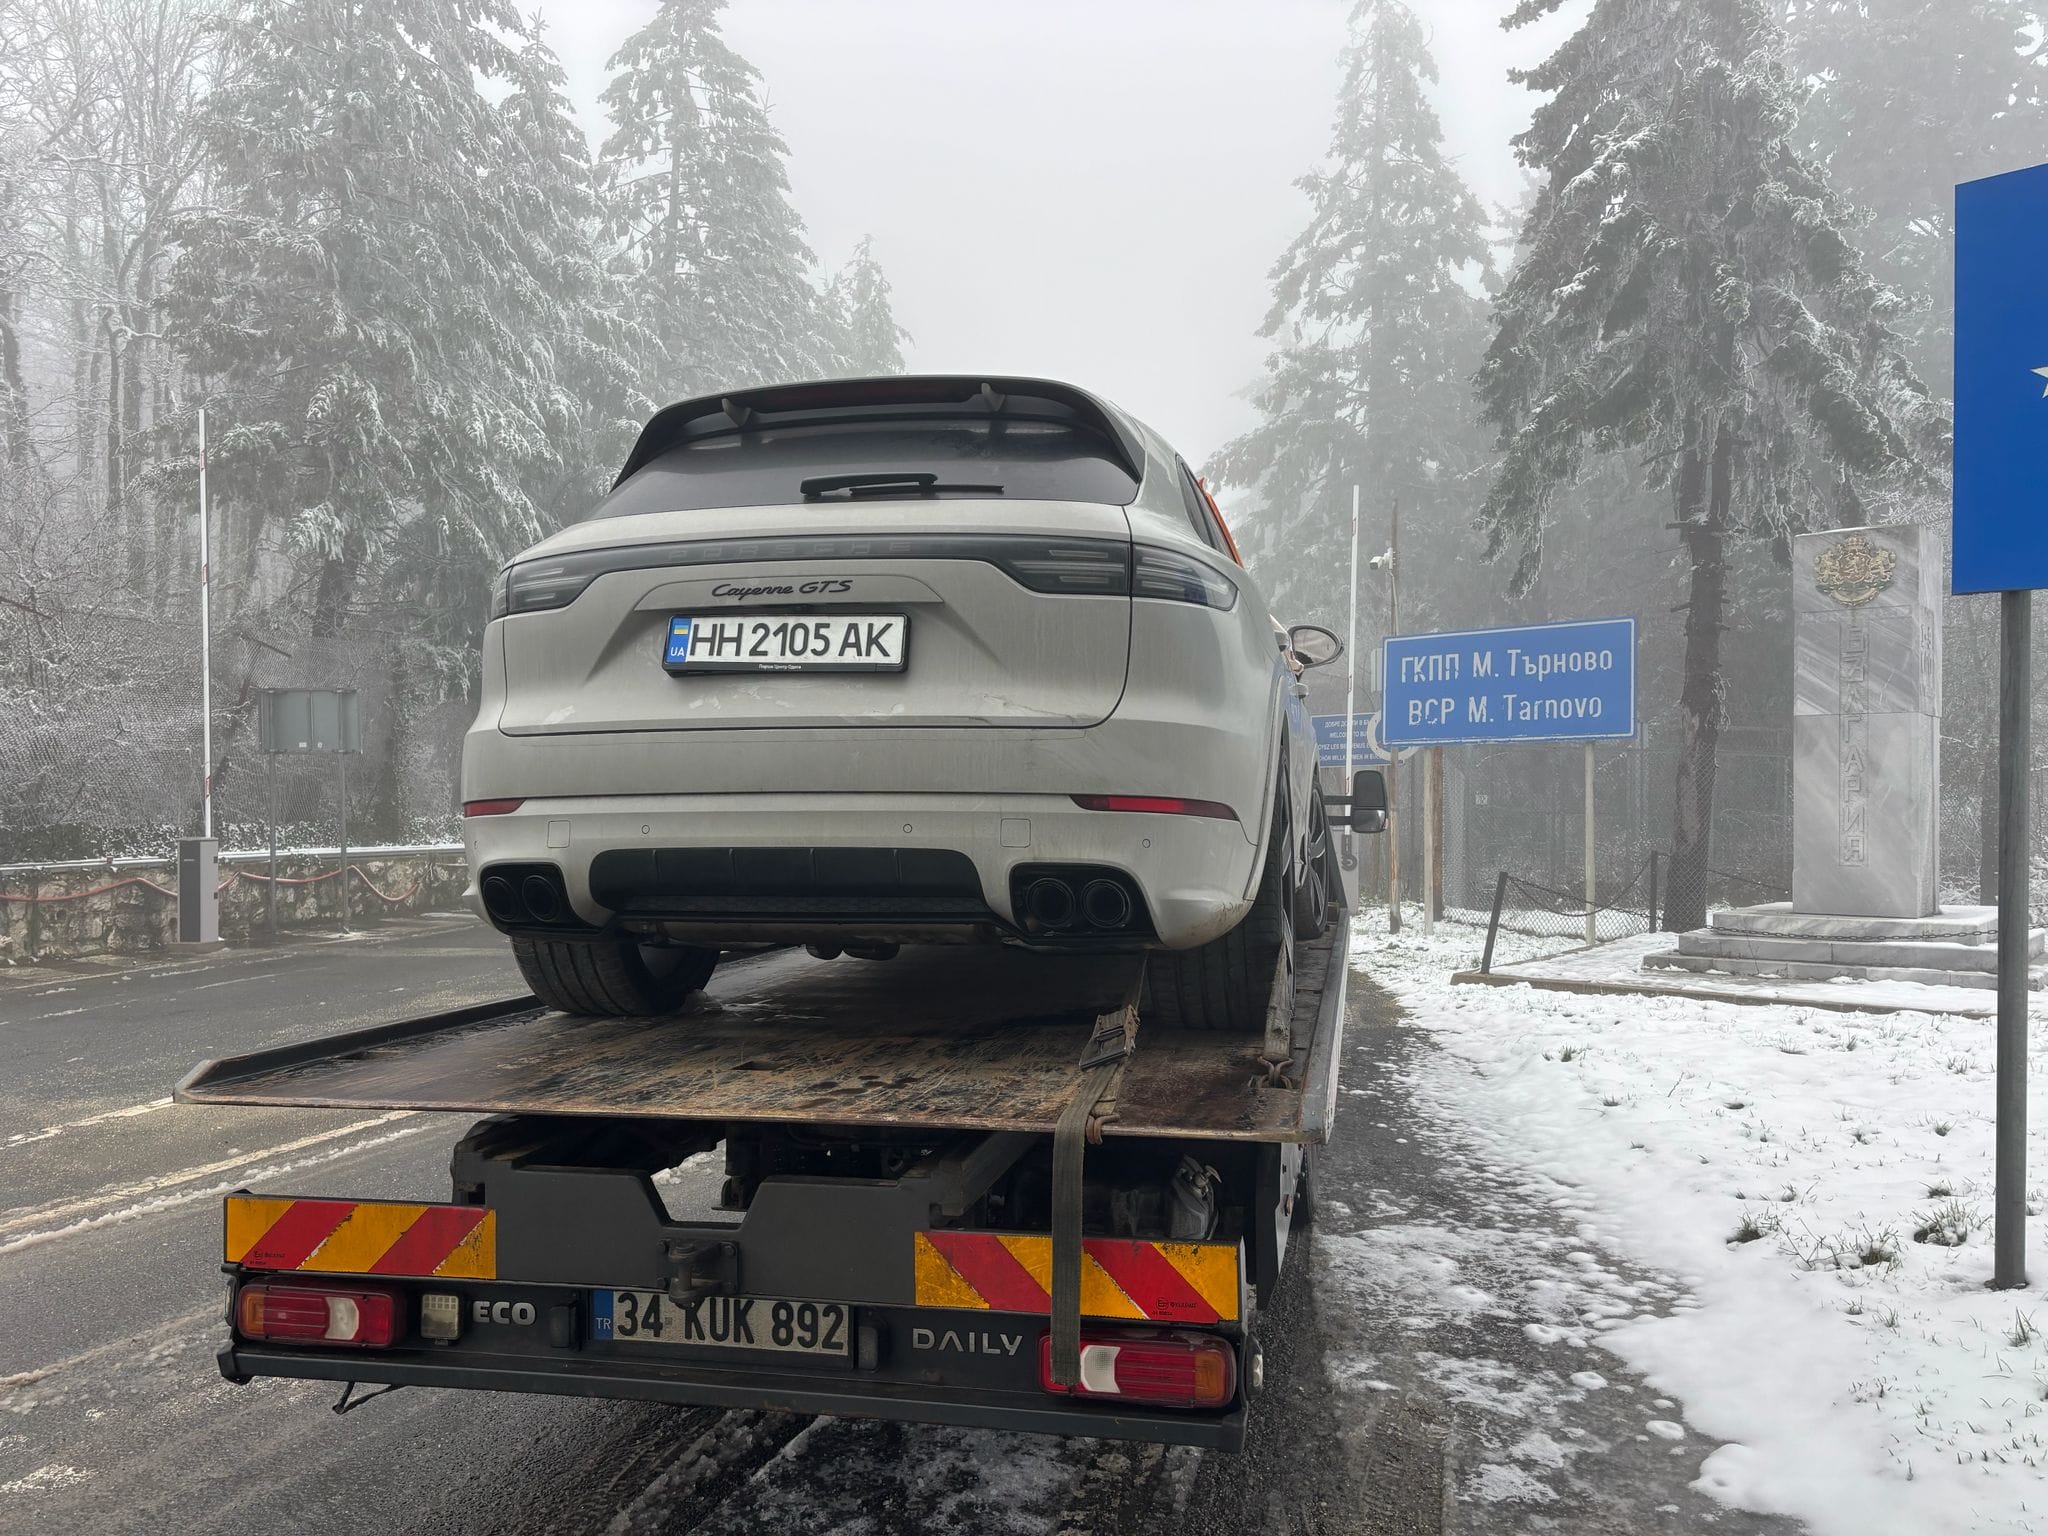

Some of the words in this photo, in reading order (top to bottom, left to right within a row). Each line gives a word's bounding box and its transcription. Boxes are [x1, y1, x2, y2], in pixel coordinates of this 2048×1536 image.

[668, 543, 911, 560] PORSCHE
[712, 583, 793, 601] Cayenne
[799, 580, 853, 594] GTS
[670, 647, 685, 657] UA
[748, 622, 830, 657] 2105
[838, 622, 893, 657] AK
[1401, 653, 1459, 683] ГКПП
[1472, 651, 1500, 678] М.
[1507, 649, 1613, 682] Търново
[1408, 698, 1455, 726] BCP
[1468, 696, 1494, 723] M.
[1503, 694, 1602, 721] Tarnovo
[472, 1300, 537, 1326] ECO
[595, 1317, 611, 1330] TR
[617, 1292, 664, 1338] 34
[680, 1296, 755, 1345] KUK
[771, 1301, 845, 1350] 892
[911, 1327, 1024, 1356] DAILY
